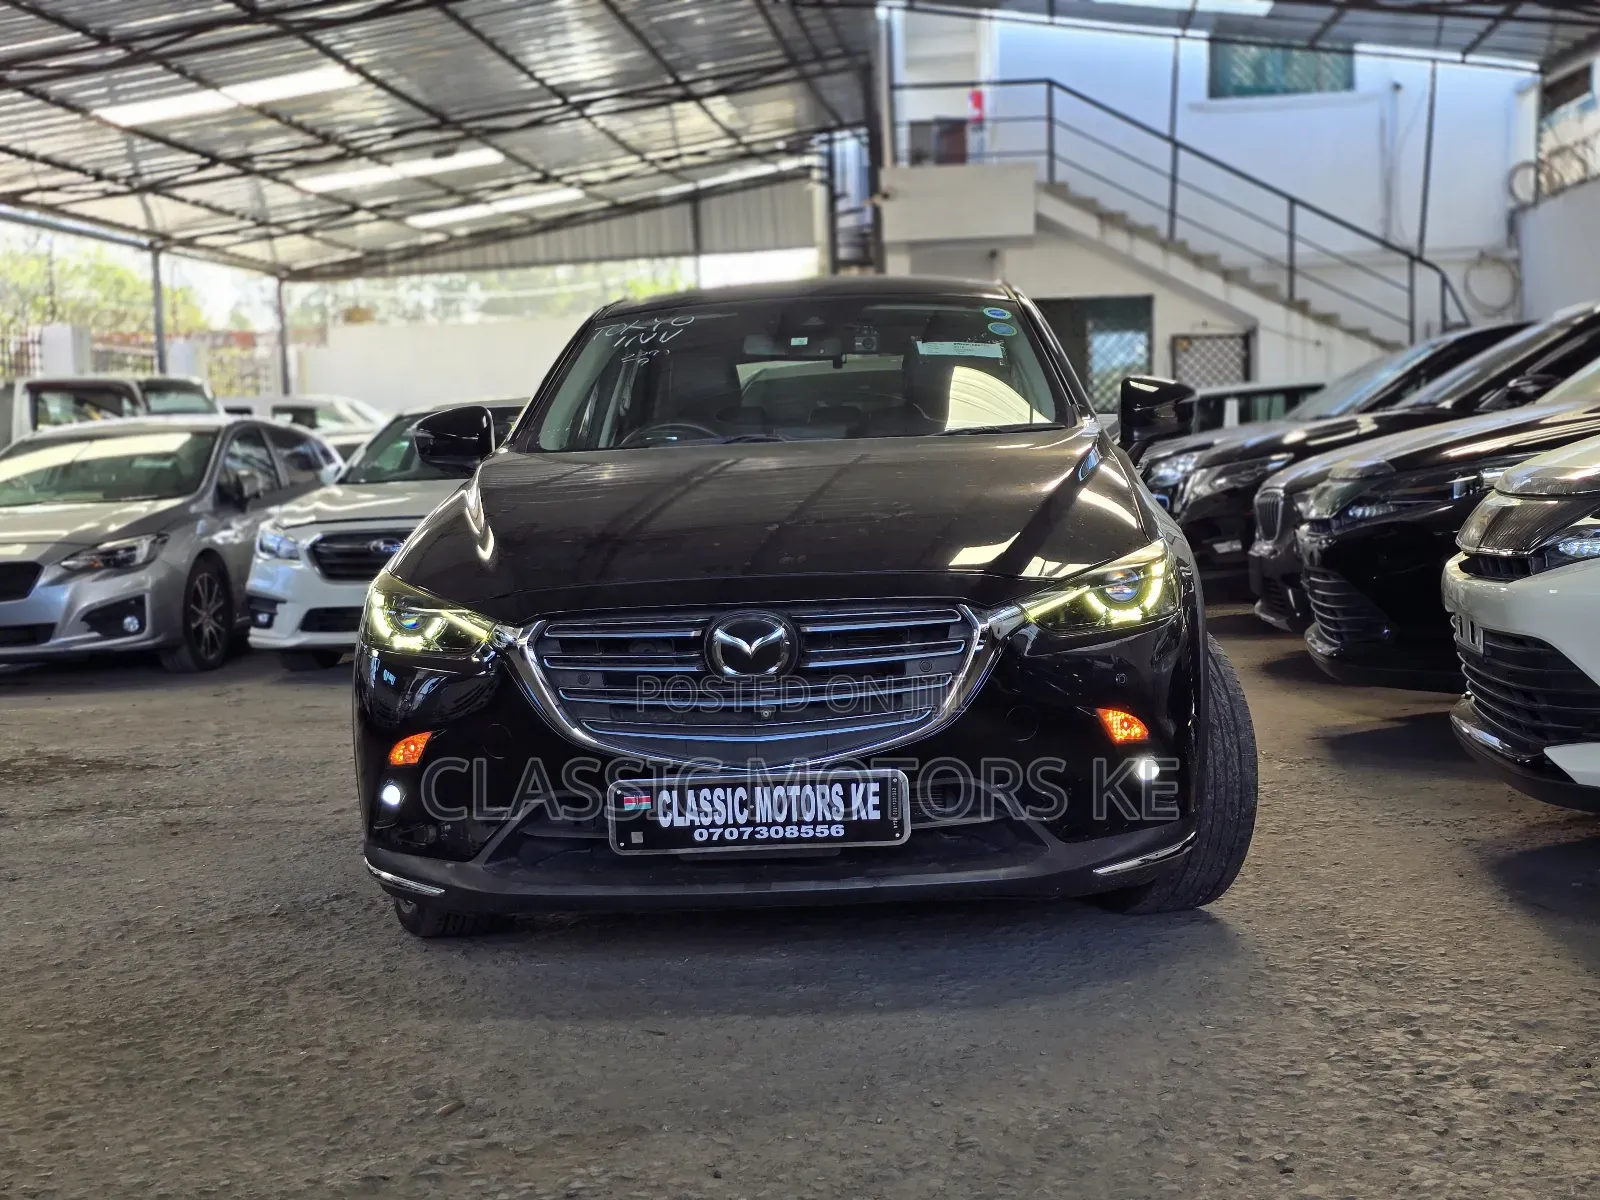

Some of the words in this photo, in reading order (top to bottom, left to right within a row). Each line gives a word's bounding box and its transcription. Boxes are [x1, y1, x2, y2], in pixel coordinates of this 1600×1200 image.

[657, 787, 749, 828] CLASSIC
[755, 782, 846, 823] MOTORS
[851, 781, 882, 822] KE
[693, 824, 846, 842] 0707308556
